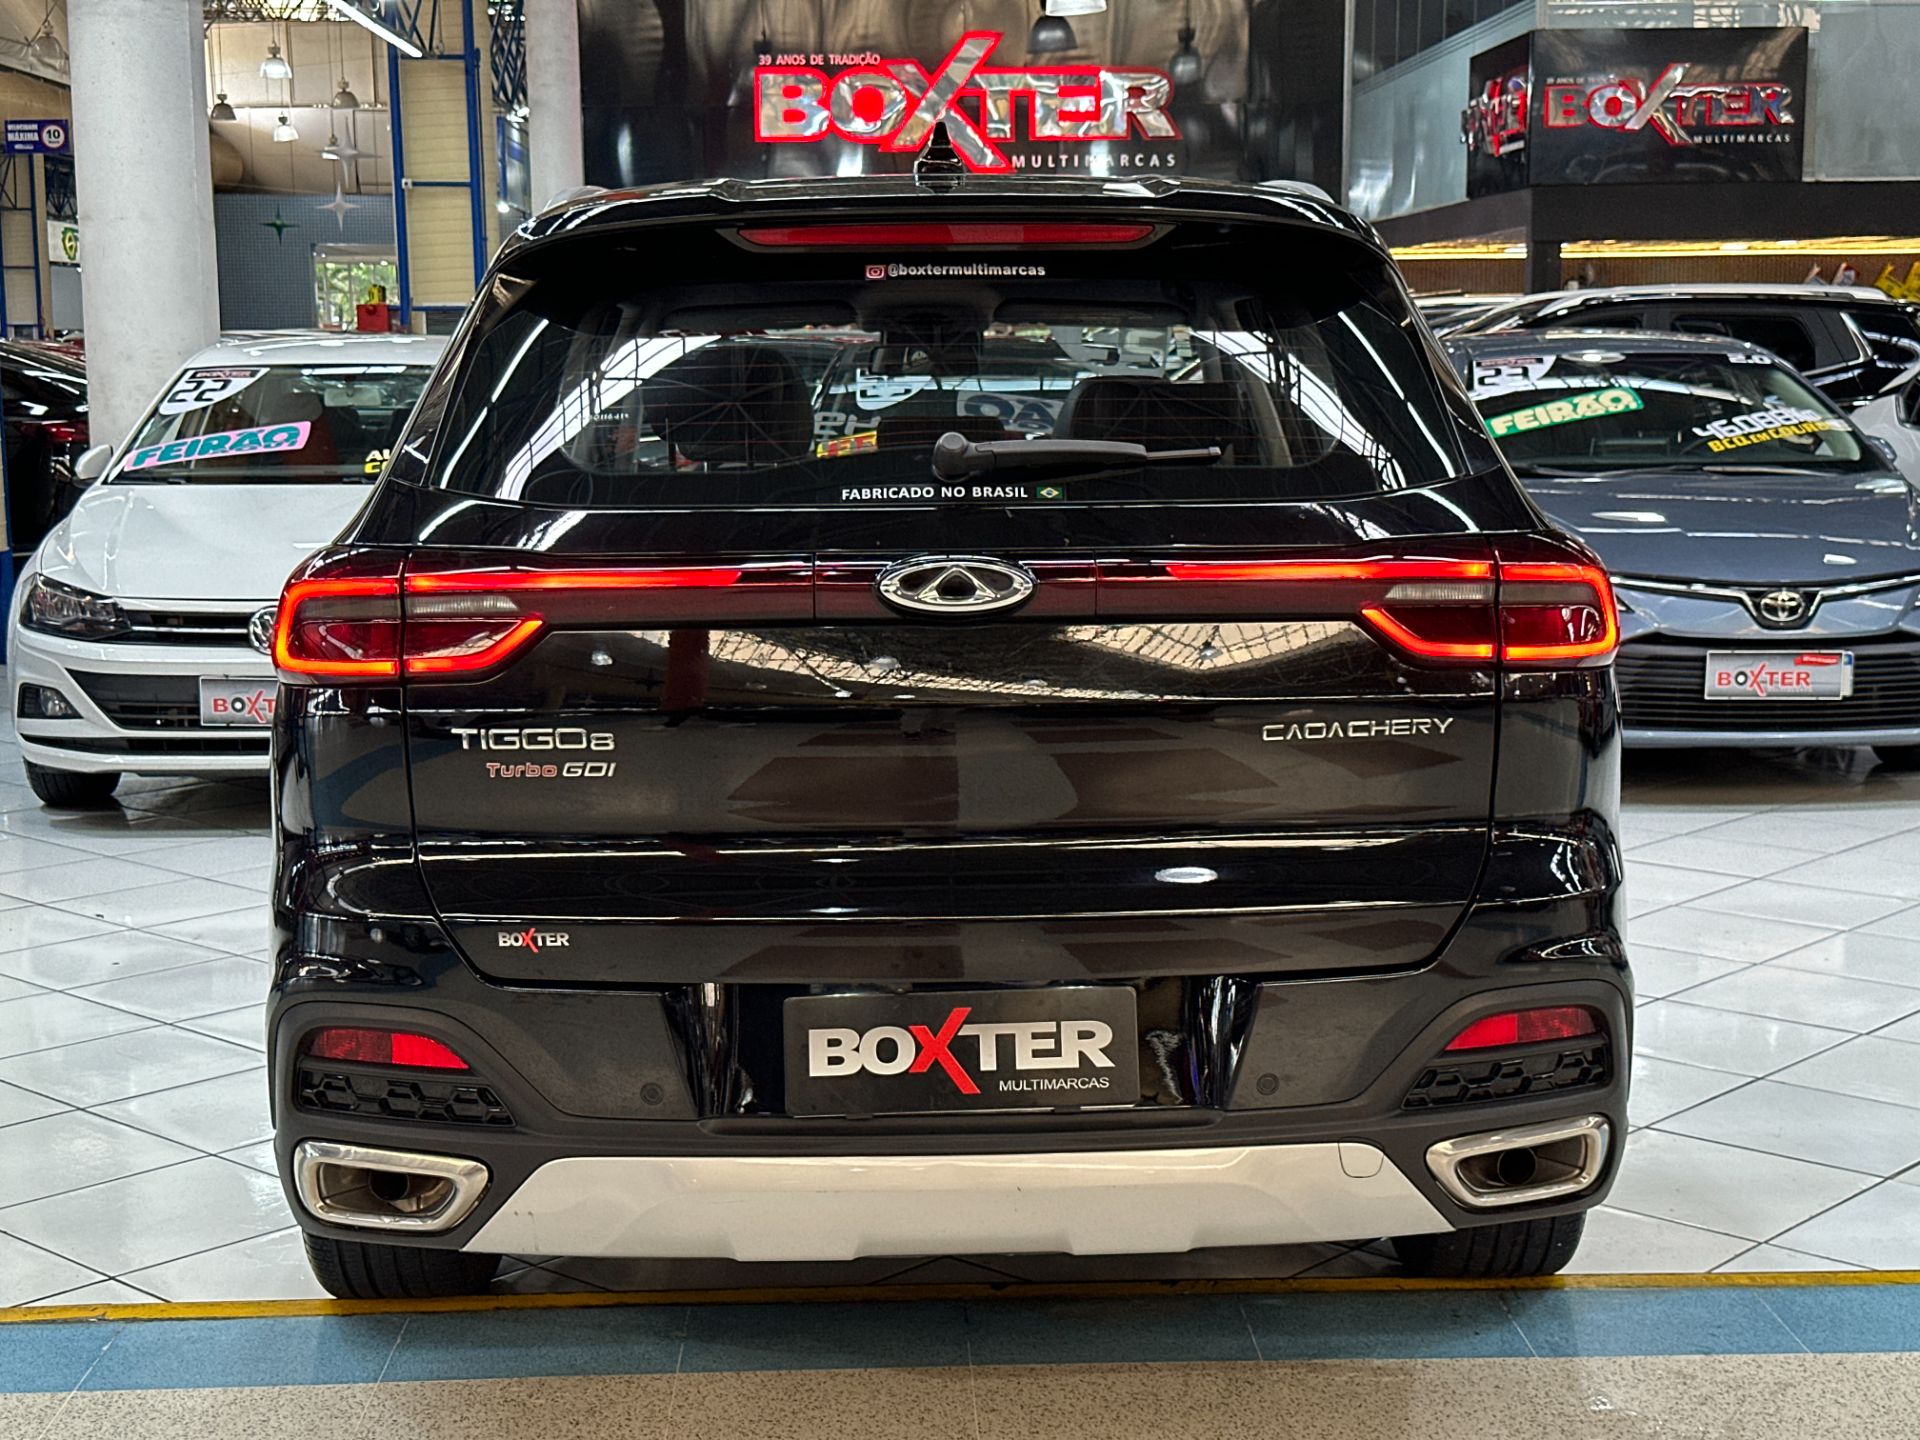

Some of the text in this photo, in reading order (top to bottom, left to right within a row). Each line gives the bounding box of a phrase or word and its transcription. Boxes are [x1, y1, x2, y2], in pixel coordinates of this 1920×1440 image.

[758, 51, 881, 66] 39 ANOS DE TRADIÇÃO
[754, 31, 1182, 173] BOXTER
[1543, 62, 1795, 146] BOXTER
[46, 128, 61, 139] 10
[1694, 133, 1792, 144] MULTIMARCAS
[887, 263, 1046, 277] @boxtermultimarcas
[167, 380, 233, 403] 22
[842, 486, 1028, 500] FABRICADO NO BRASIL
[1716, 661, 1812, 697] BOXTER
[486, 762, 616, 778] Turbo GDI
[498, 927, 570, 953] BOXTER
[808, 1007, 1116, 1095] BOXTER
[1000, 1076, 1110, 1092] MULTIMARCAS
